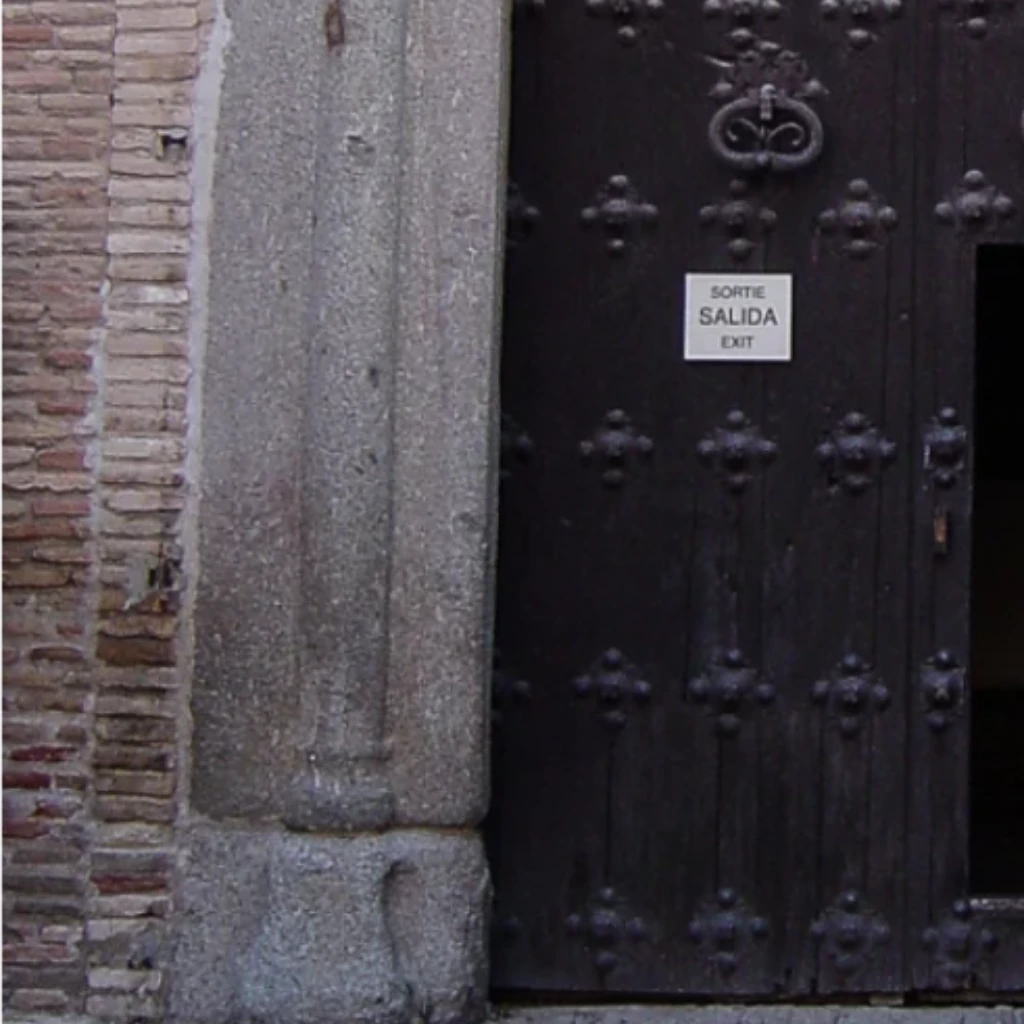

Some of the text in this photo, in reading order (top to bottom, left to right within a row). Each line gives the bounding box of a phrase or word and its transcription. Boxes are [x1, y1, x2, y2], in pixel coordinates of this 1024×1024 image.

[710, 284, 766, 299] SORTIE
[699, 306, 779, 327] SALIDA
[720, 335, 755, 349] EXIT
